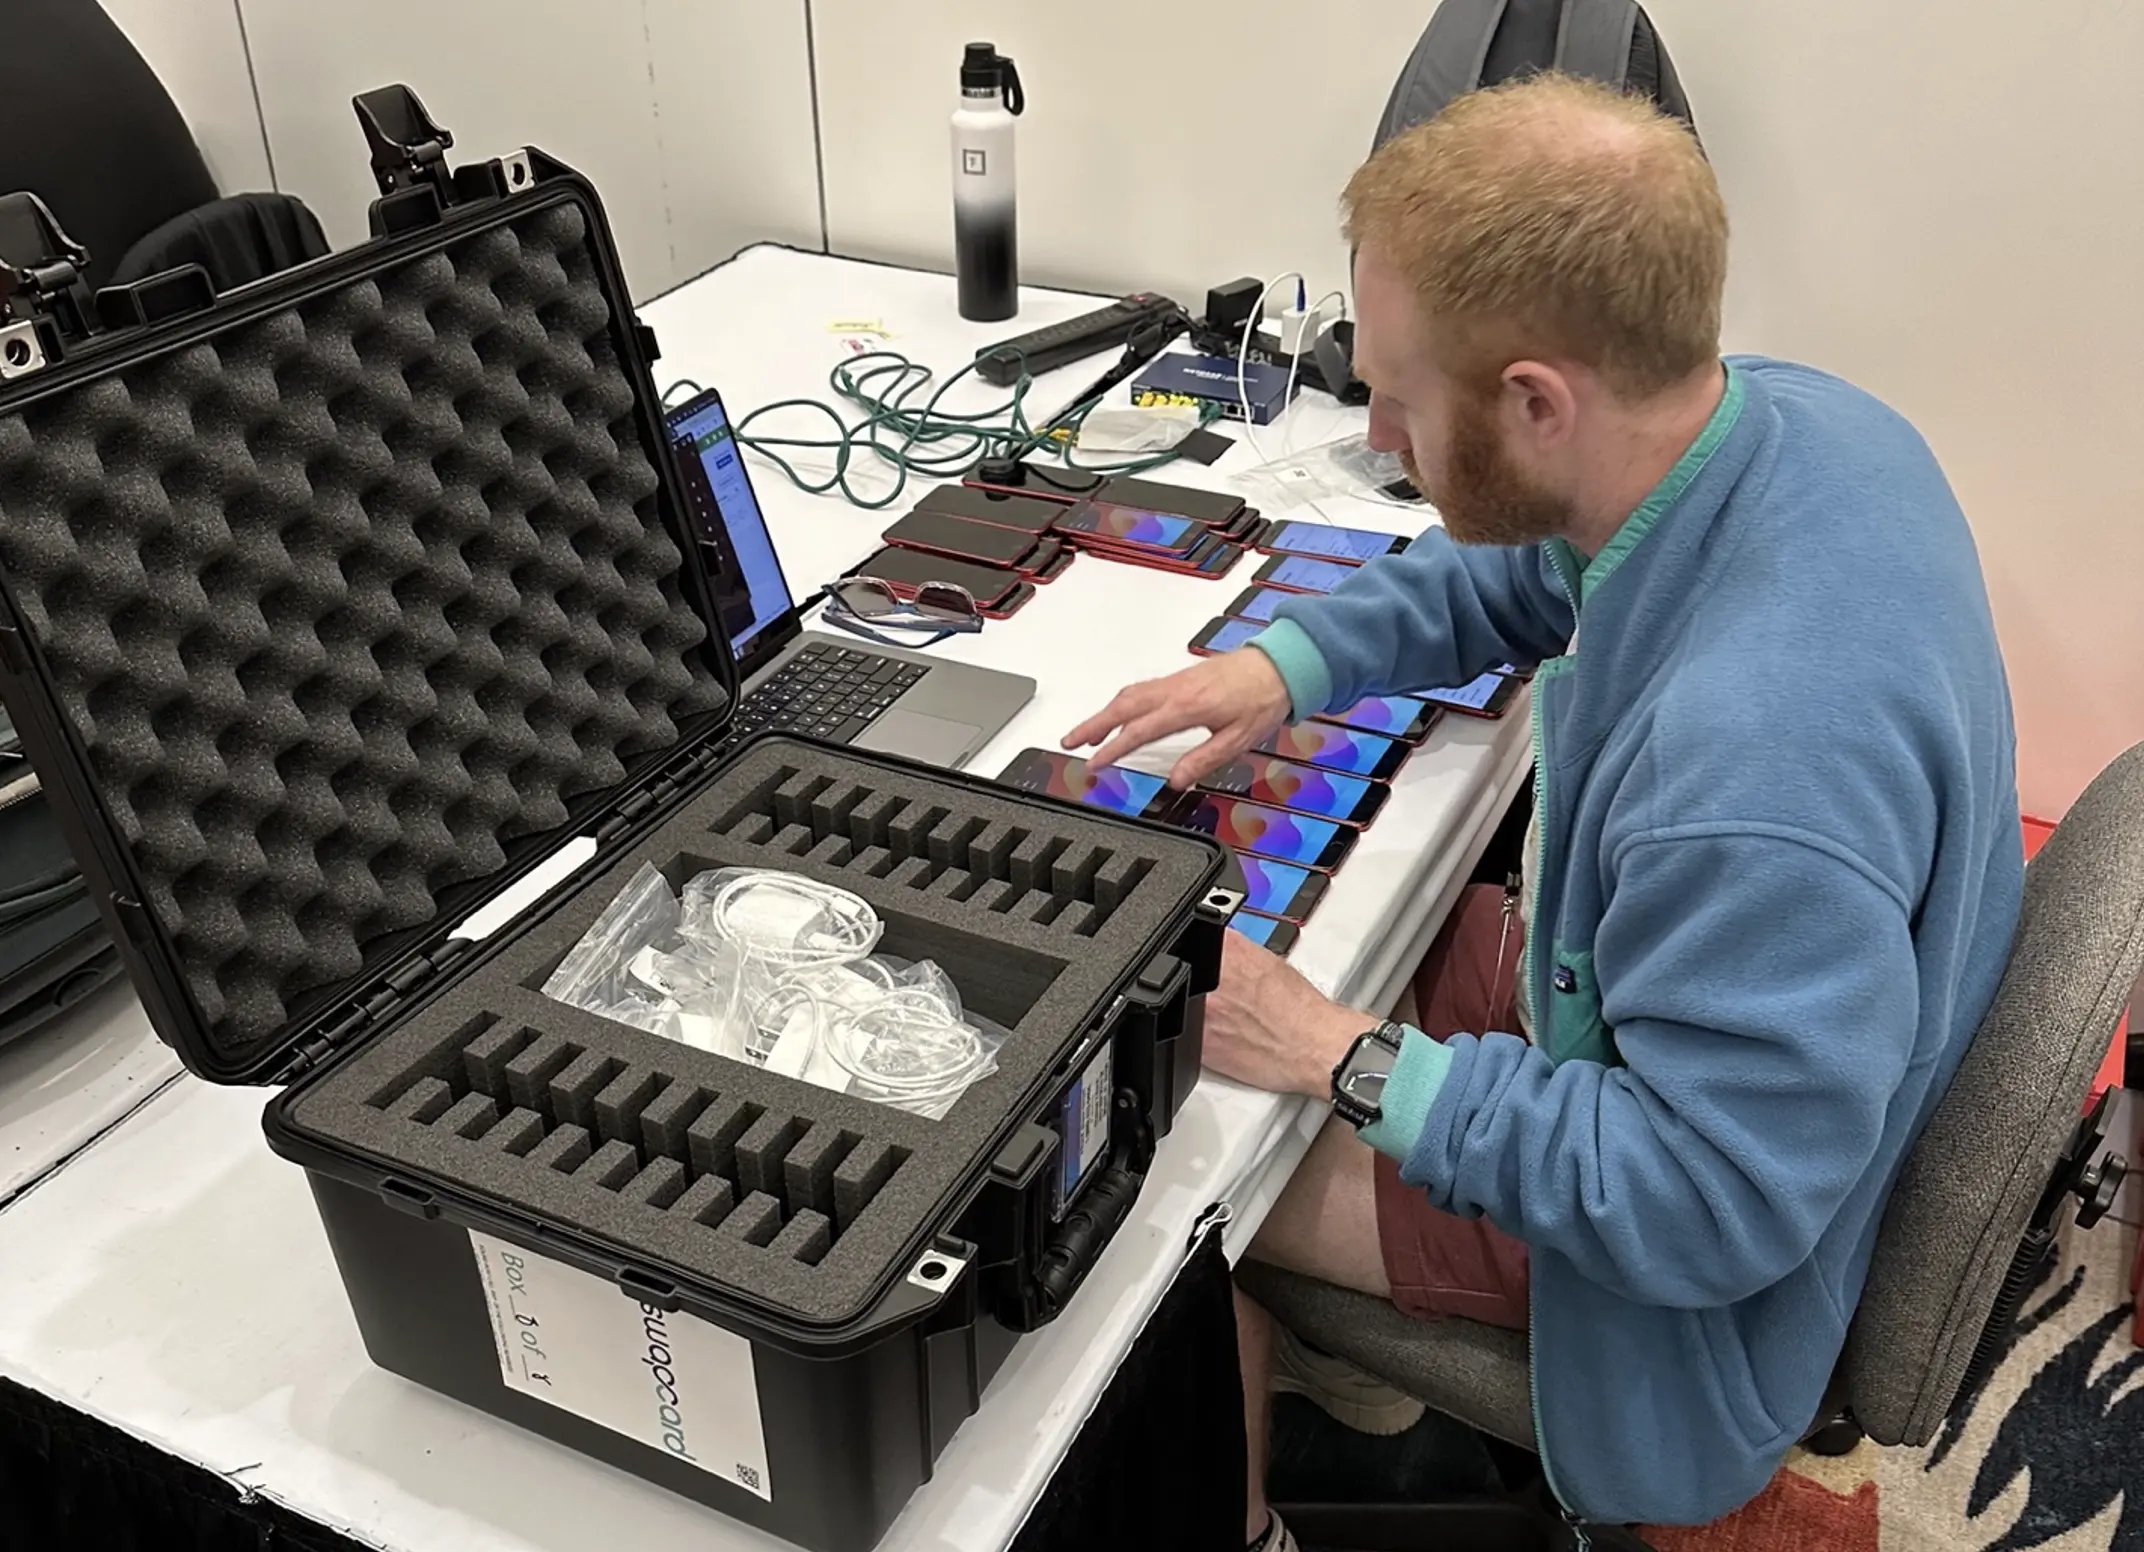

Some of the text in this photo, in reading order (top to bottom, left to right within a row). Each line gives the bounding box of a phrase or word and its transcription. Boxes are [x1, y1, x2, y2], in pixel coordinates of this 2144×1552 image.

[501, 1251, 527, 1296] Box
[521, 1331, 547, 1360] of
[641, 1301, 697, 1461] swapcard
